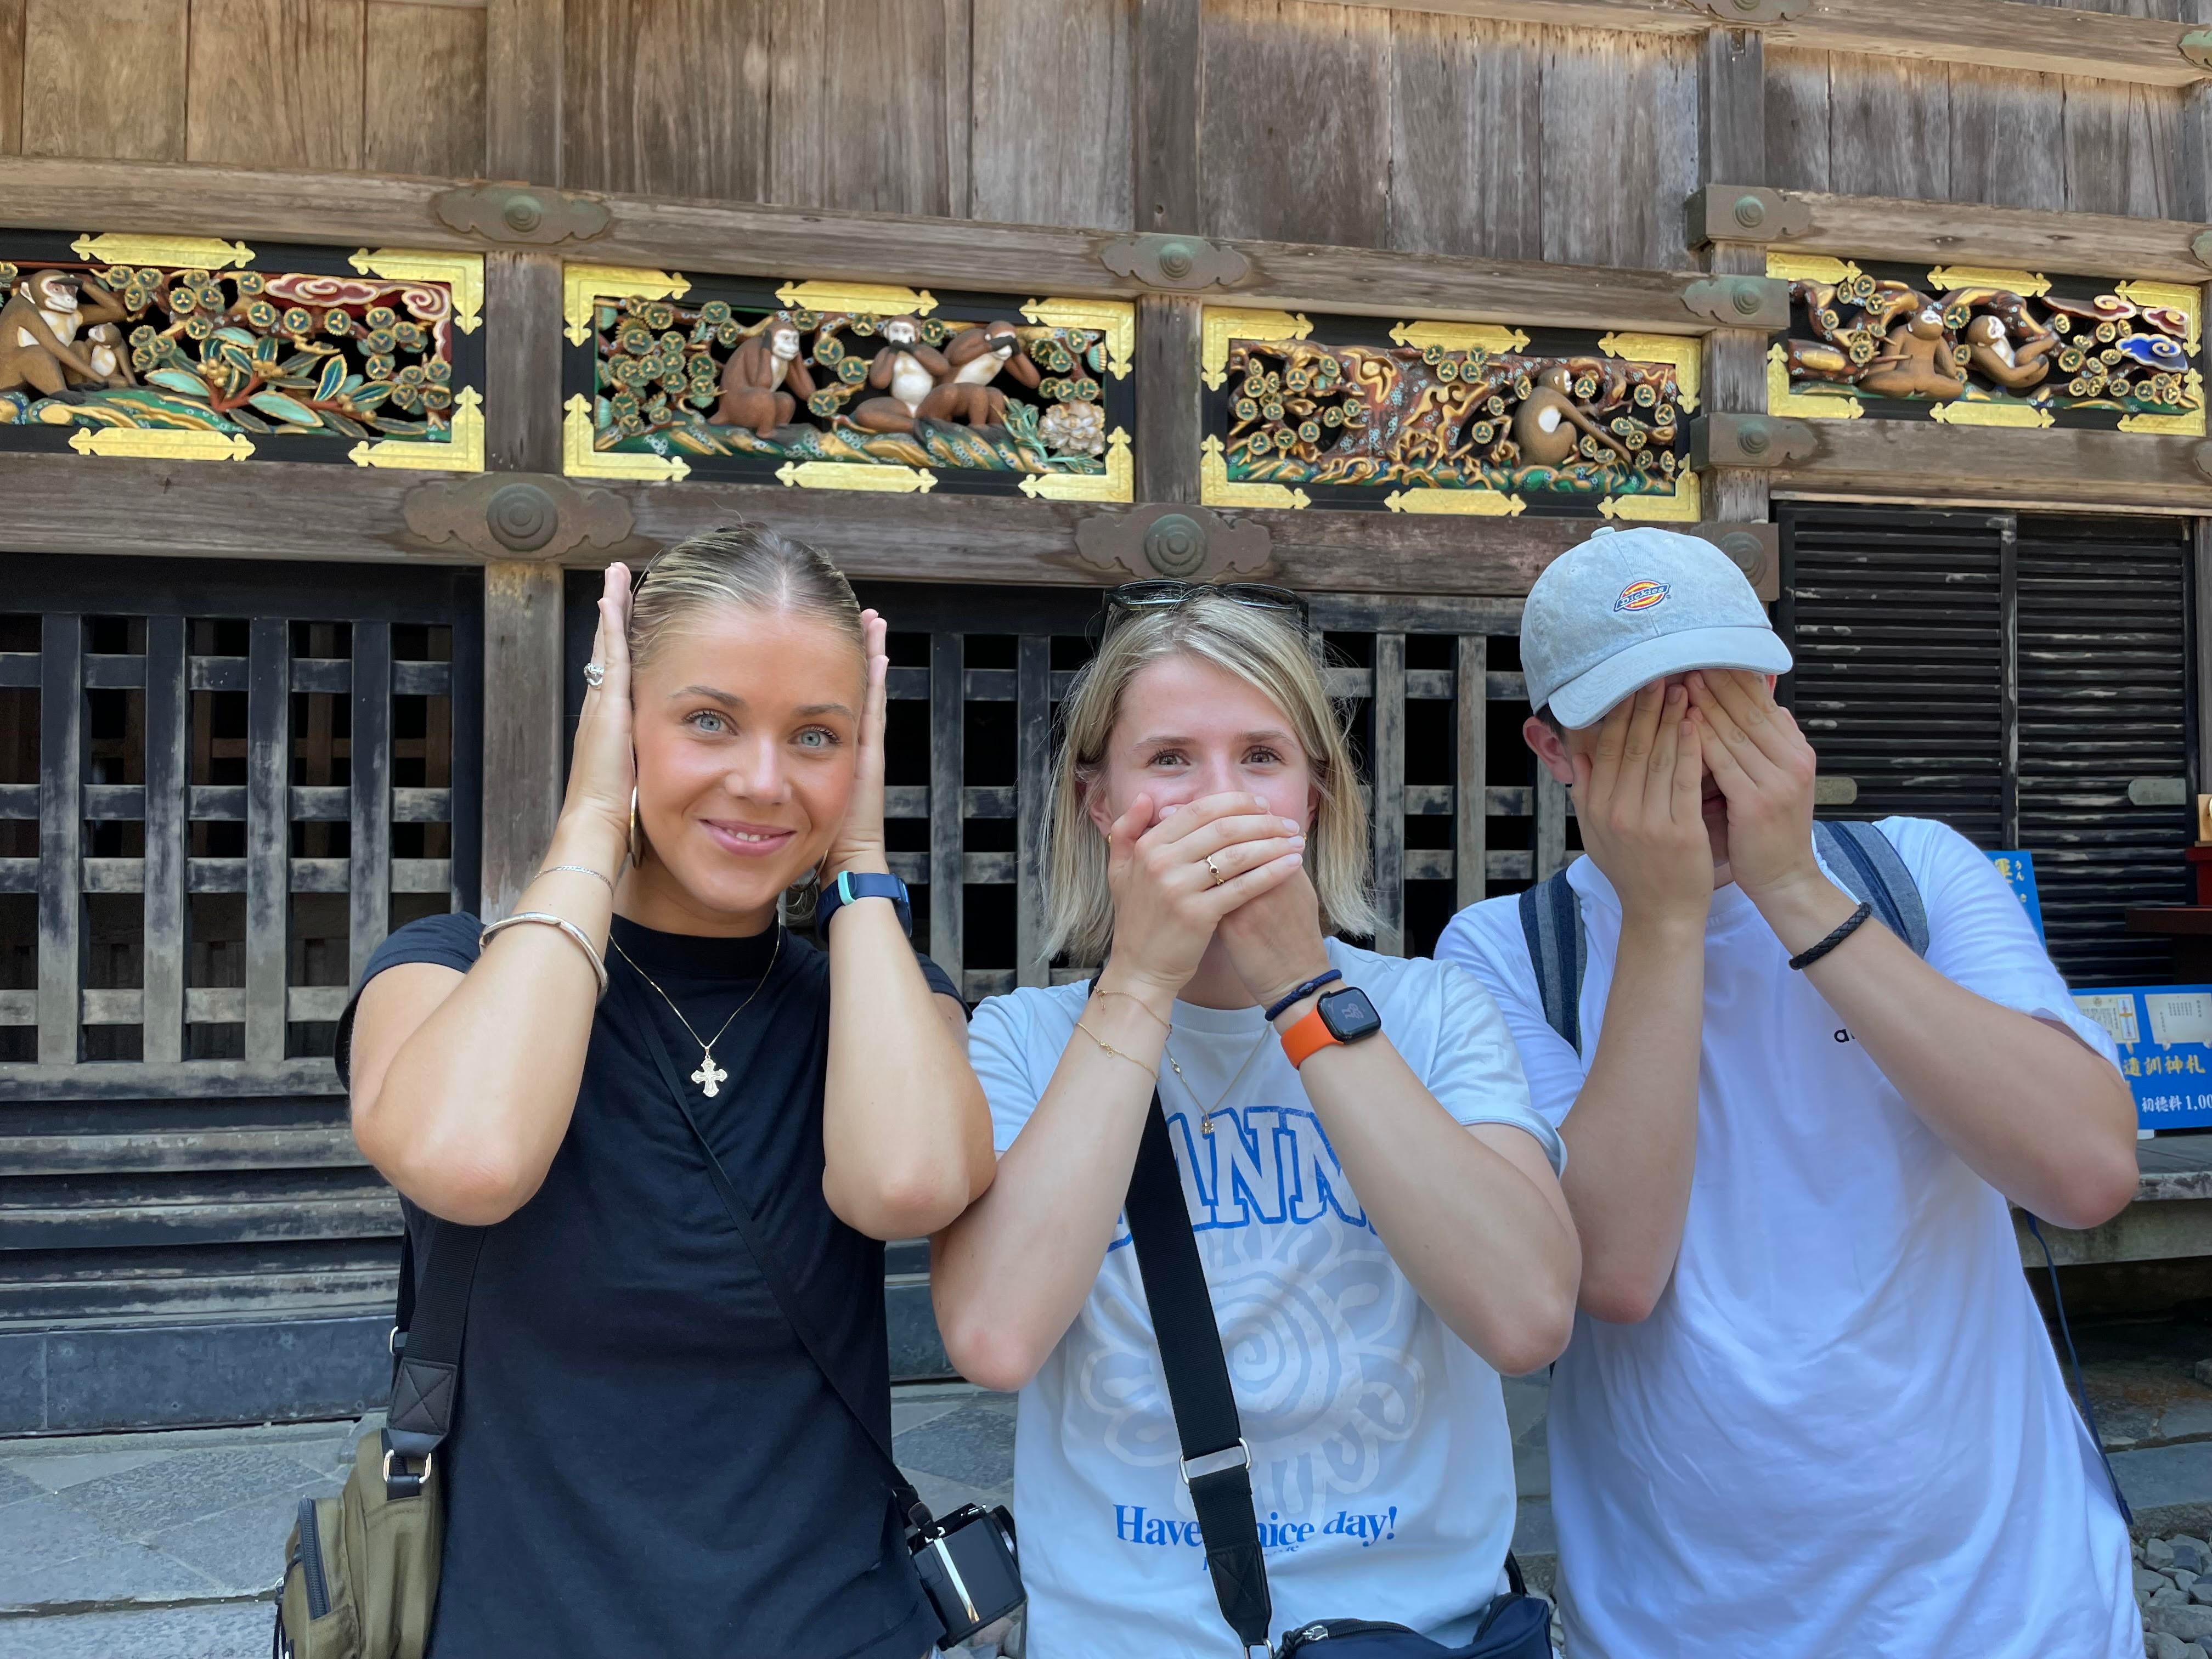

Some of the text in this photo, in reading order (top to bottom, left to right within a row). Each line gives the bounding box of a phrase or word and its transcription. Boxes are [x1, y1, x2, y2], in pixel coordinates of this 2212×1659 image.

[1620, 586, 1664, 606] Dickies
[1113, 1504, 1398, 1548] Have nice day!
